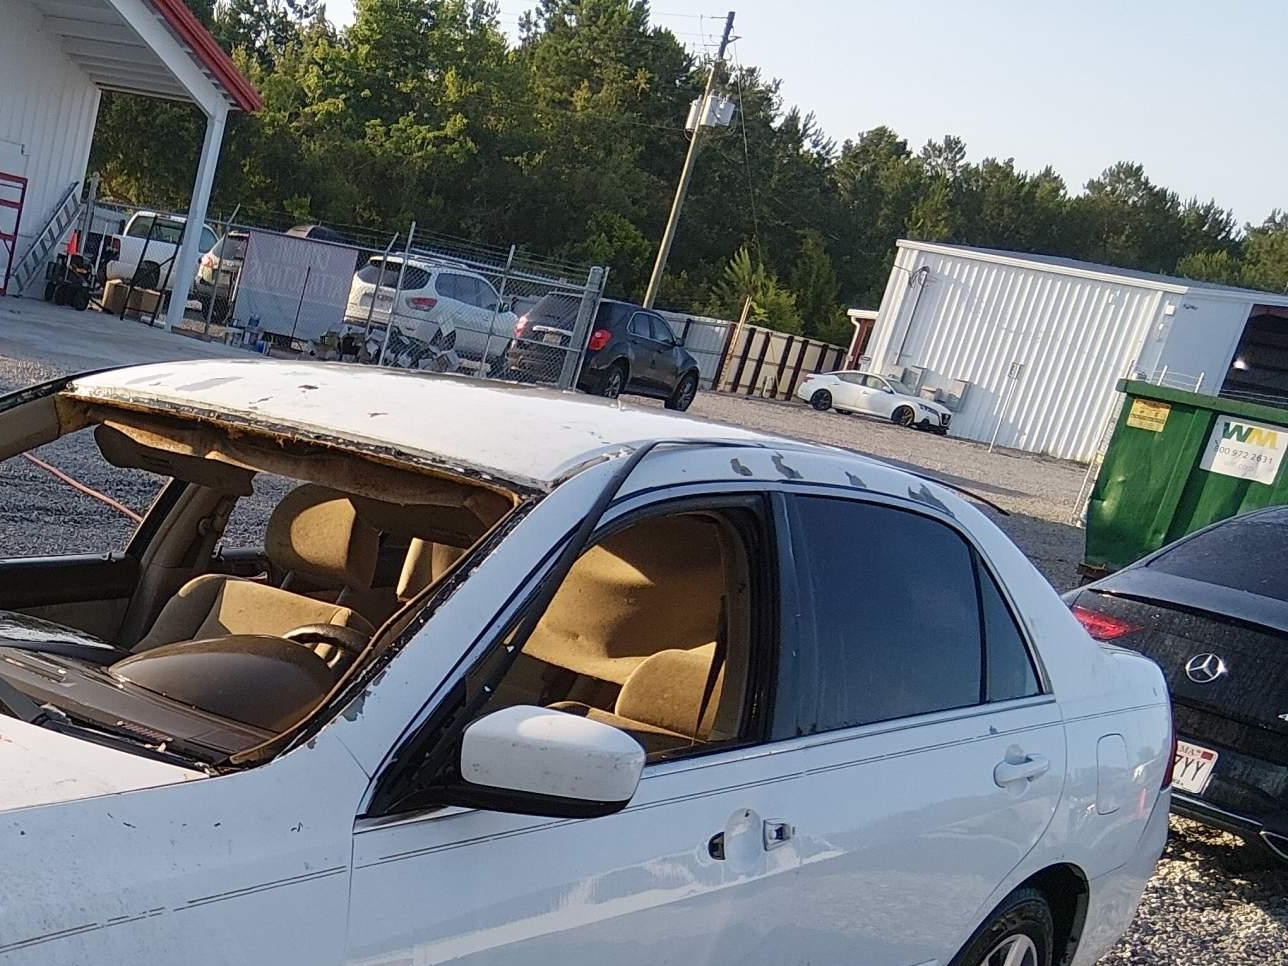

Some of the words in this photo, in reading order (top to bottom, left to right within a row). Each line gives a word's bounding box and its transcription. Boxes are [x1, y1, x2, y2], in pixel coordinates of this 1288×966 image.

[1223, 422, 1278, 449] WM
[1231, 448, 1249, 459] 972
[1250, 453, 1273, 464] 2631
